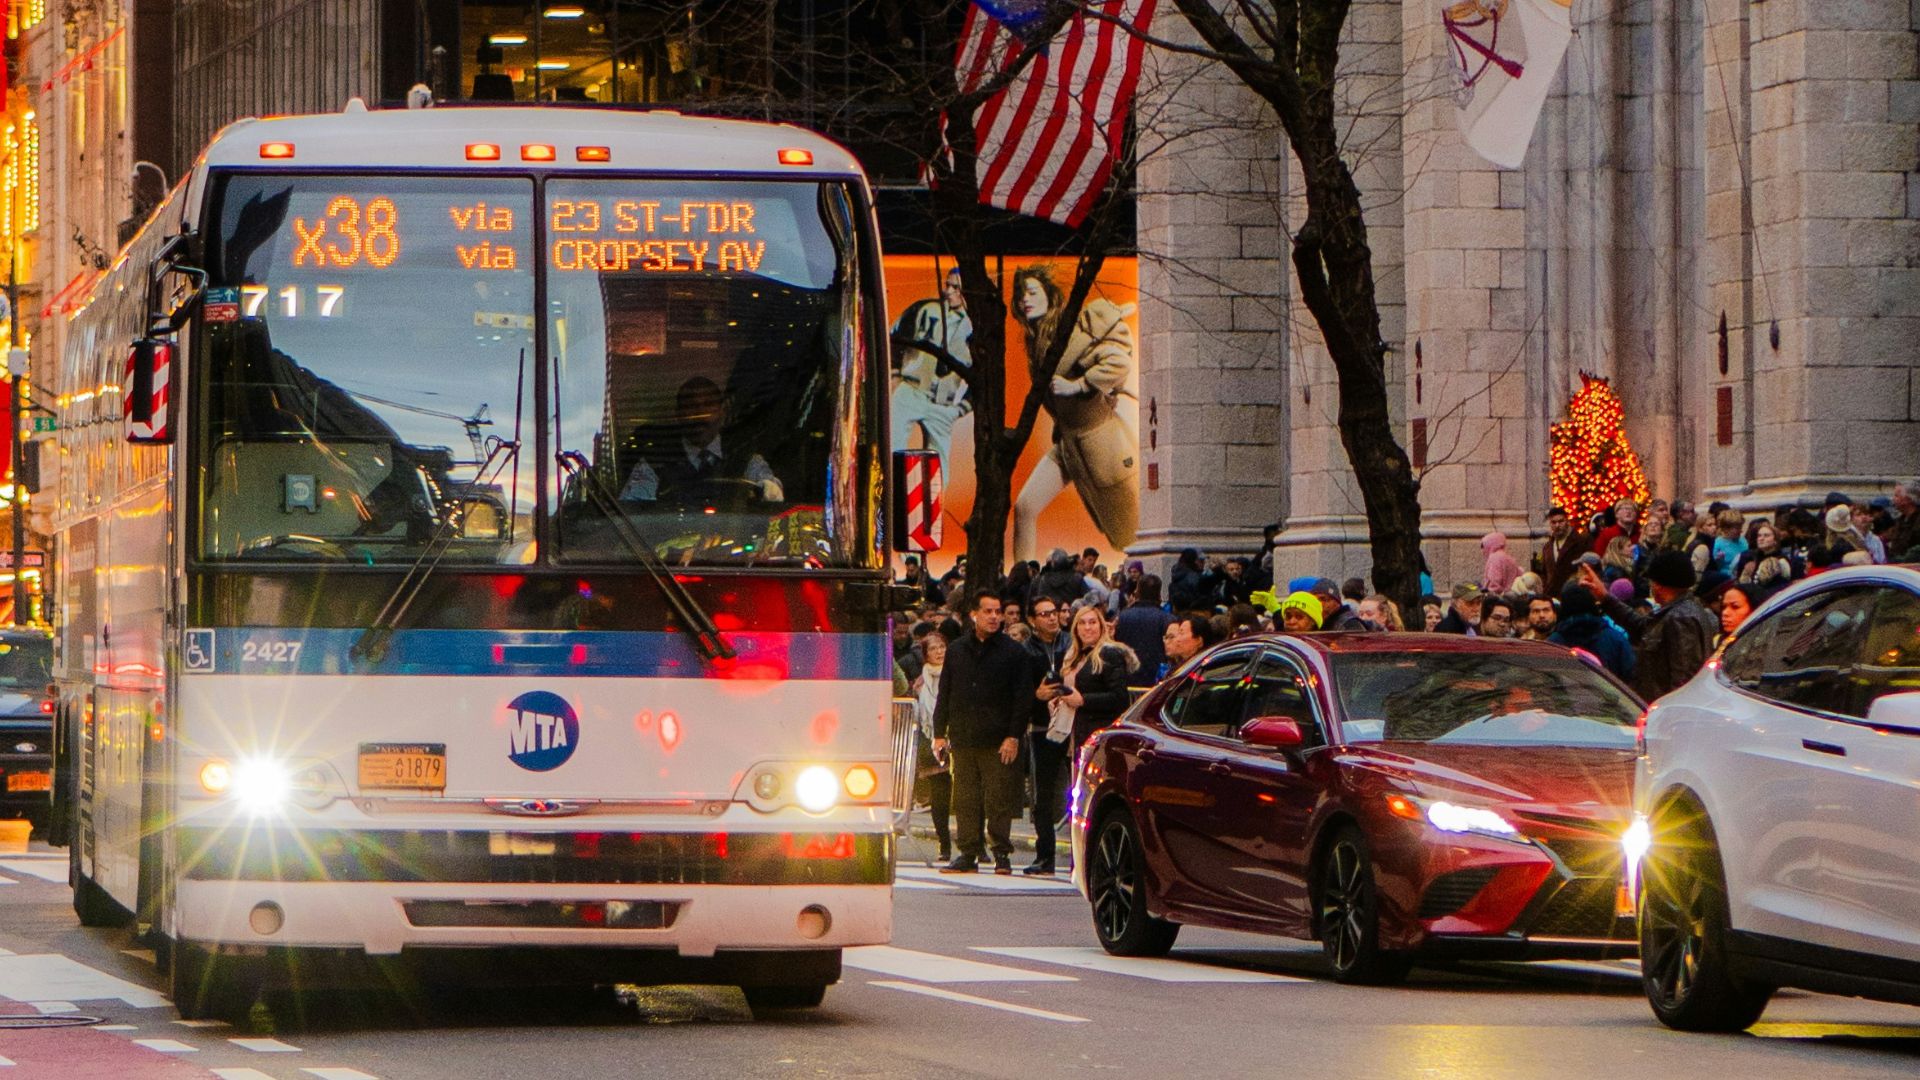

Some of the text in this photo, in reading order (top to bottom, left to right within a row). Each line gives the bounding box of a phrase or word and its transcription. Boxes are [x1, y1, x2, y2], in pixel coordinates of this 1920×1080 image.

[449, 201, 756, 233] via 23 ST-FDR
[456, 240, 765, 271] via CROPSEY AV
[242, 641, 301, 661] 2427
[506, 706, 568, 756] MTA
